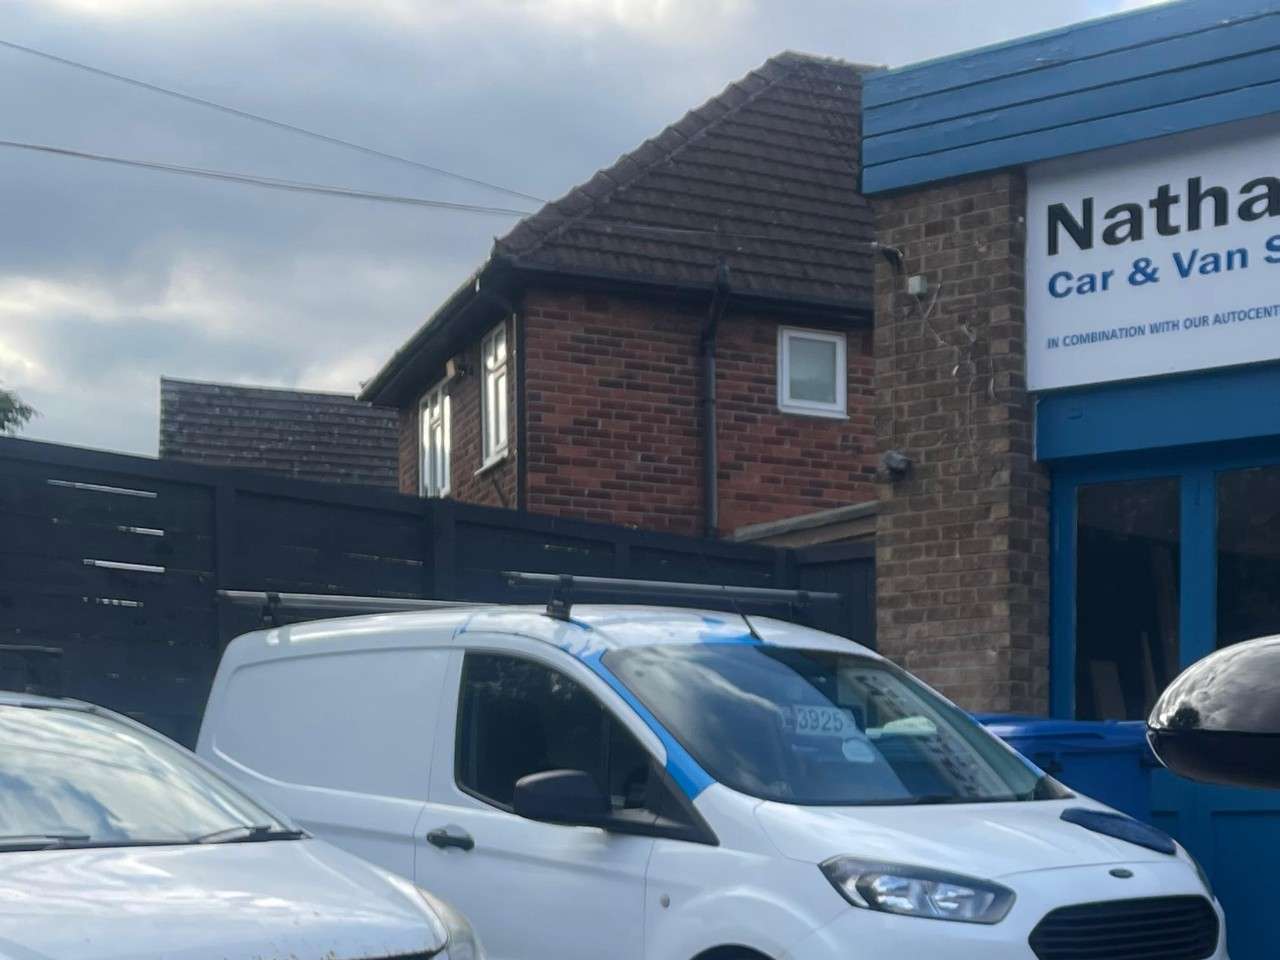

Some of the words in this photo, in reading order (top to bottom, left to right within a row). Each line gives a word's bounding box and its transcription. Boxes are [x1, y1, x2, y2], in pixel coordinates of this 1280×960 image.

[1048, 269, 1115, 299] Car
[1128, 257, 1160, 286] &
[1172, 247, 1249, 279] Van
[1047, 338, 1060, 350] IN
[1063, 325, 1146, 348] COMBINATION
[1149, 319, 1181, 335] WITH
[1184, 315, 1210, 330] OUR
